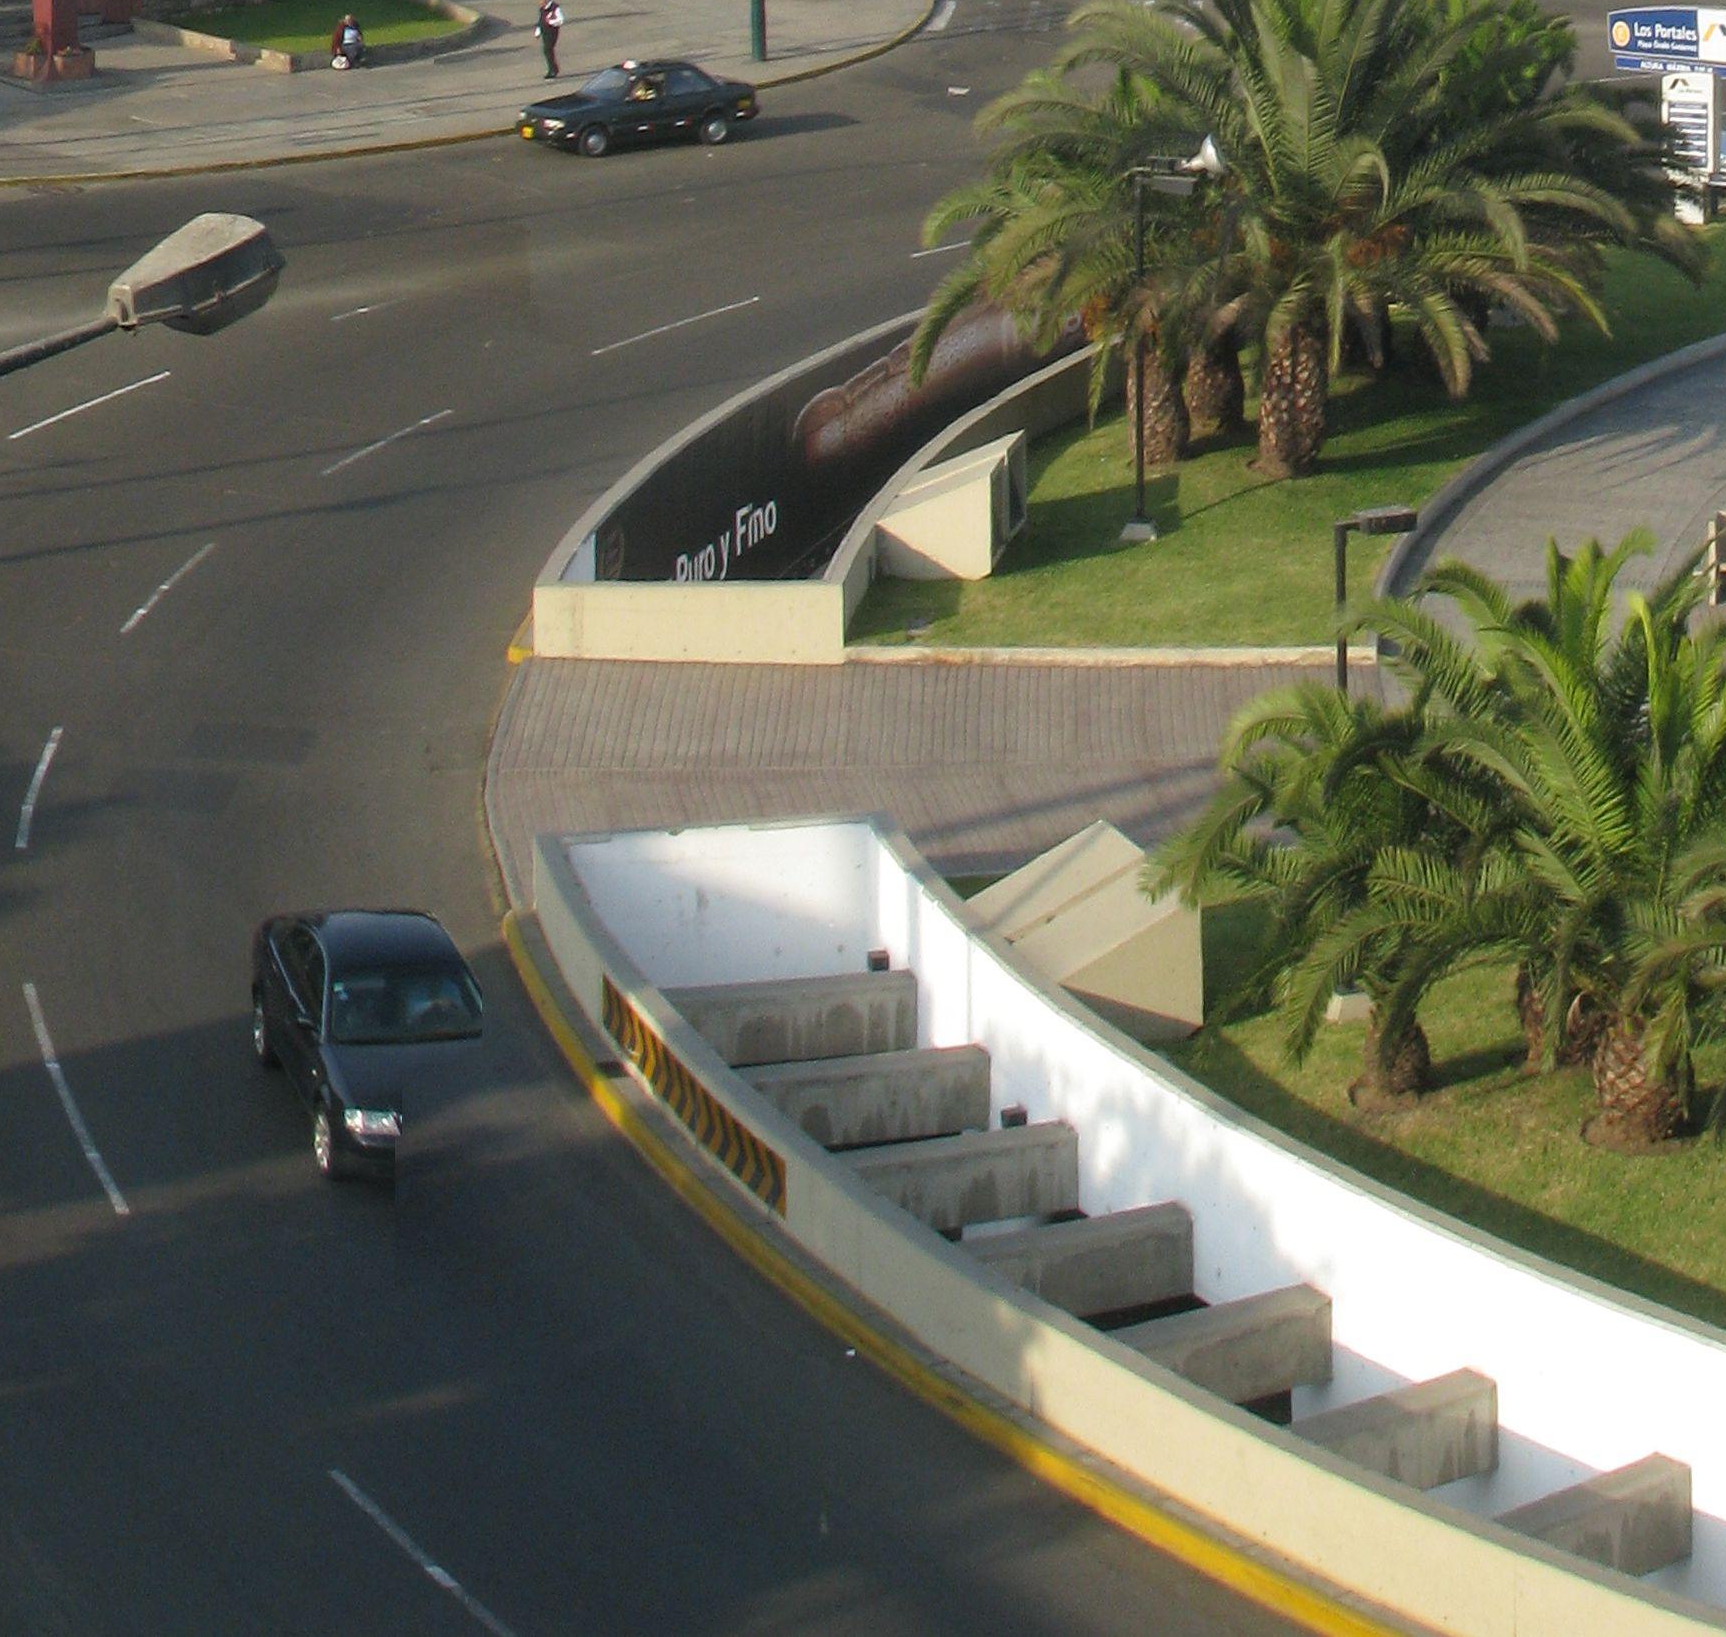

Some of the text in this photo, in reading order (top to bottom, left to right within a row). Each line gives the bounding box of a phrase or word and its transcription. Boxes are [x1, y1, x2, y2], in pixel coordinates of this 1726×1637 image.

[1634, 21, 1697, 42] Los Portales
[719, 530, 731, 580] y
[735, 500, 777, 556] Fino
